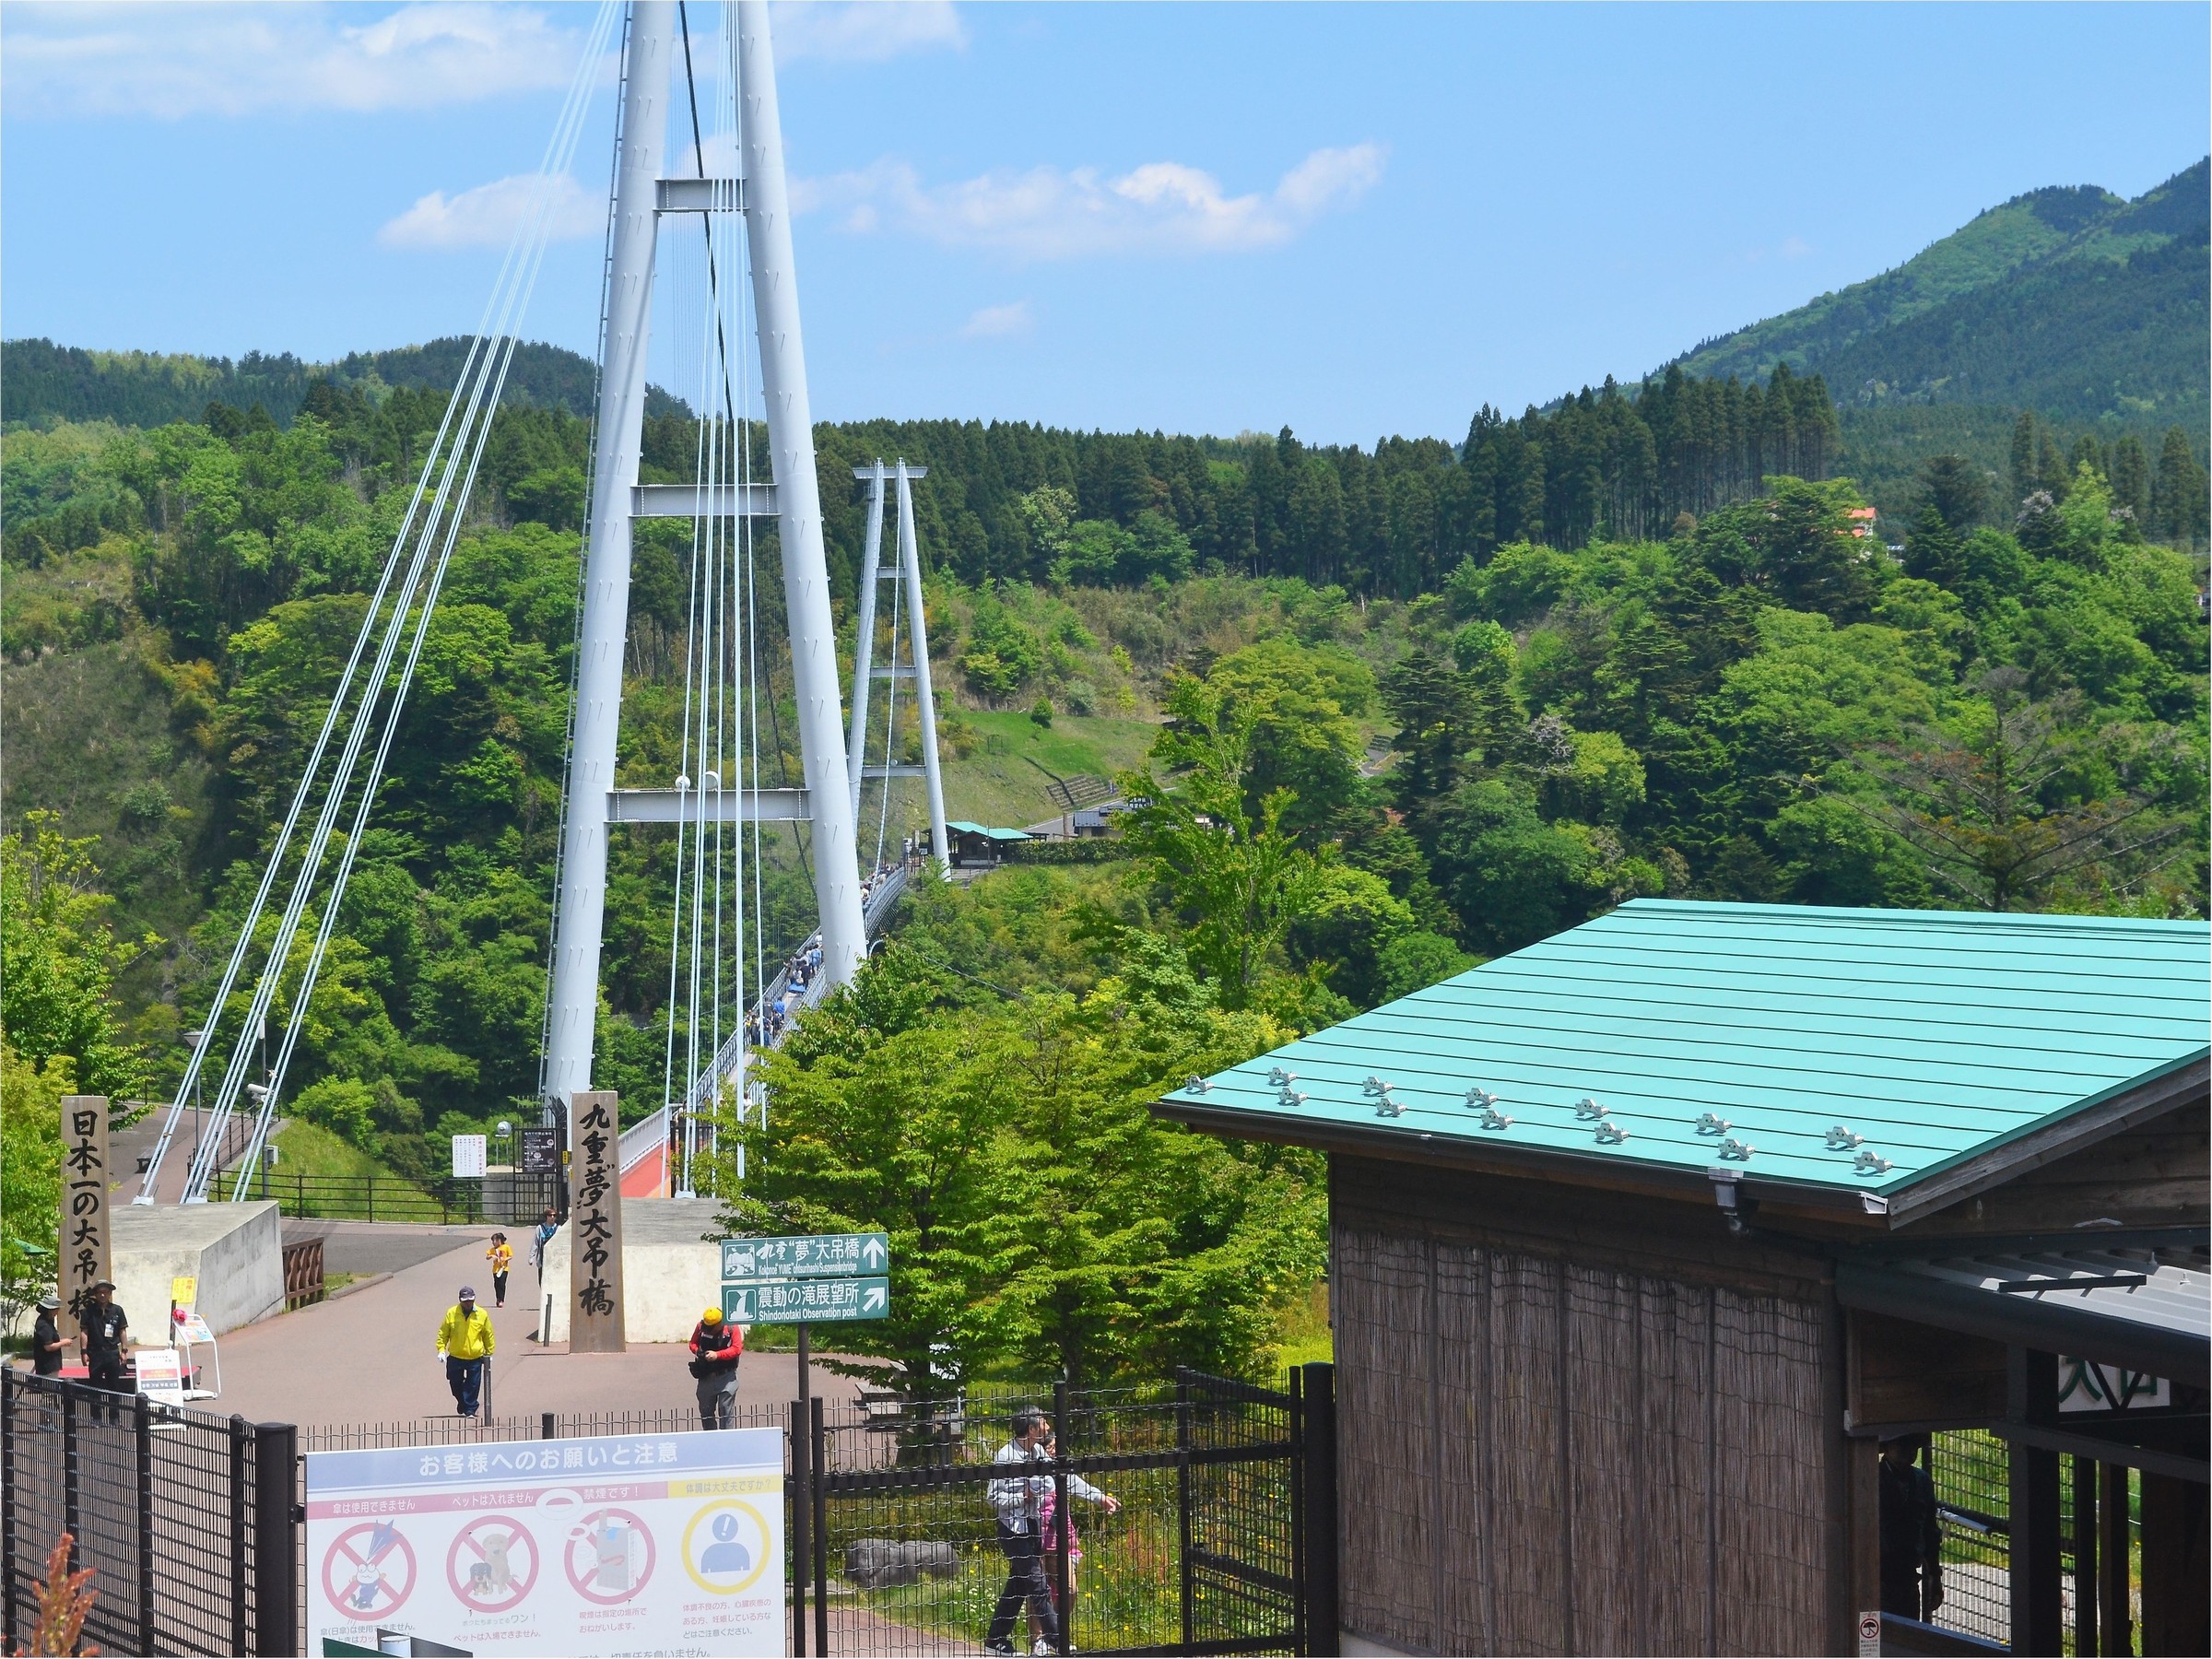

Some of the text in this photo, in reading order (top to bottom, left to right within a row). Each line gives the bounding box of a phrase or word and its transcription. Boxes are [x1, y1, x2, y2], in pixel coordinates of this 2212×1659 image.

[758, 1283, 859, 1308] 震動の滝展望所
[759, 1306, 857, 1321] Shindonotaki Observation post
[419, 1441, 677, 1477] お客様へのお願いと注意
[583, 1486, 639, 1500] 禁煙です！
[686, 1478, 771, 1494] 体調は大丈夫ですか？
[452, 1491, 535, 1507] ペットは入れません
[333, 1500, 416, 1514] 傘は使用できません
[579, 1607, 647, 1620] 喫煙は指定の場所で
[579, 1621, 636, 1633] おねがいします。
[683, 1628, 753, 1640] どはご注意ください。
